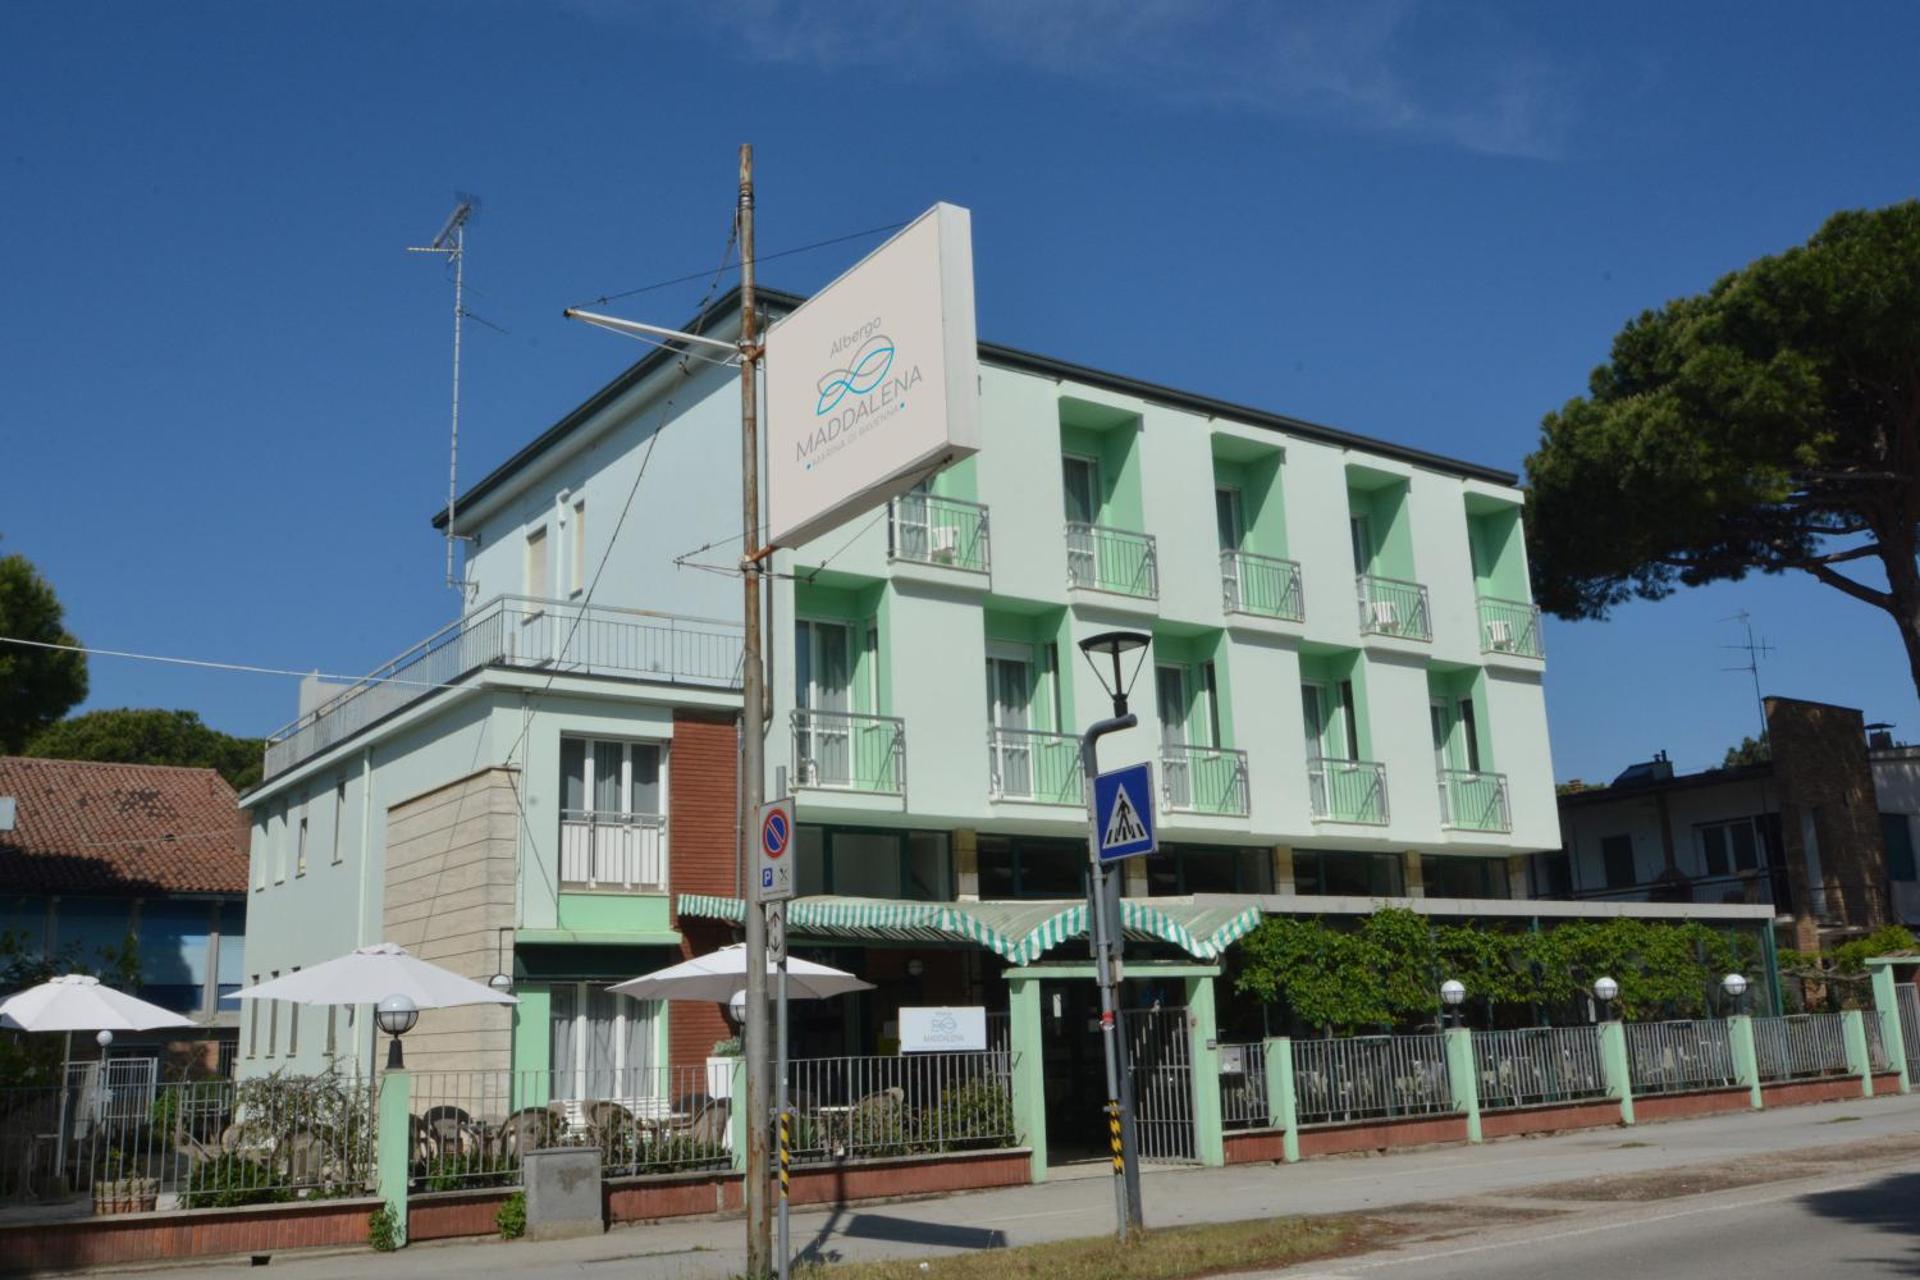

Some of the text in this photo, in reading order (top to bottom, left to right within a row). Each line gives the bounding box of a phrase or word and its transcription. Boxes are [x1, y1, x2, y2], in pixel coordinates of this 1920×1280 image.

[830, 316, 882, 359] Albergo
[796, 365, 922, 462] MADDALENA
[764, 870, 771, 886] P
